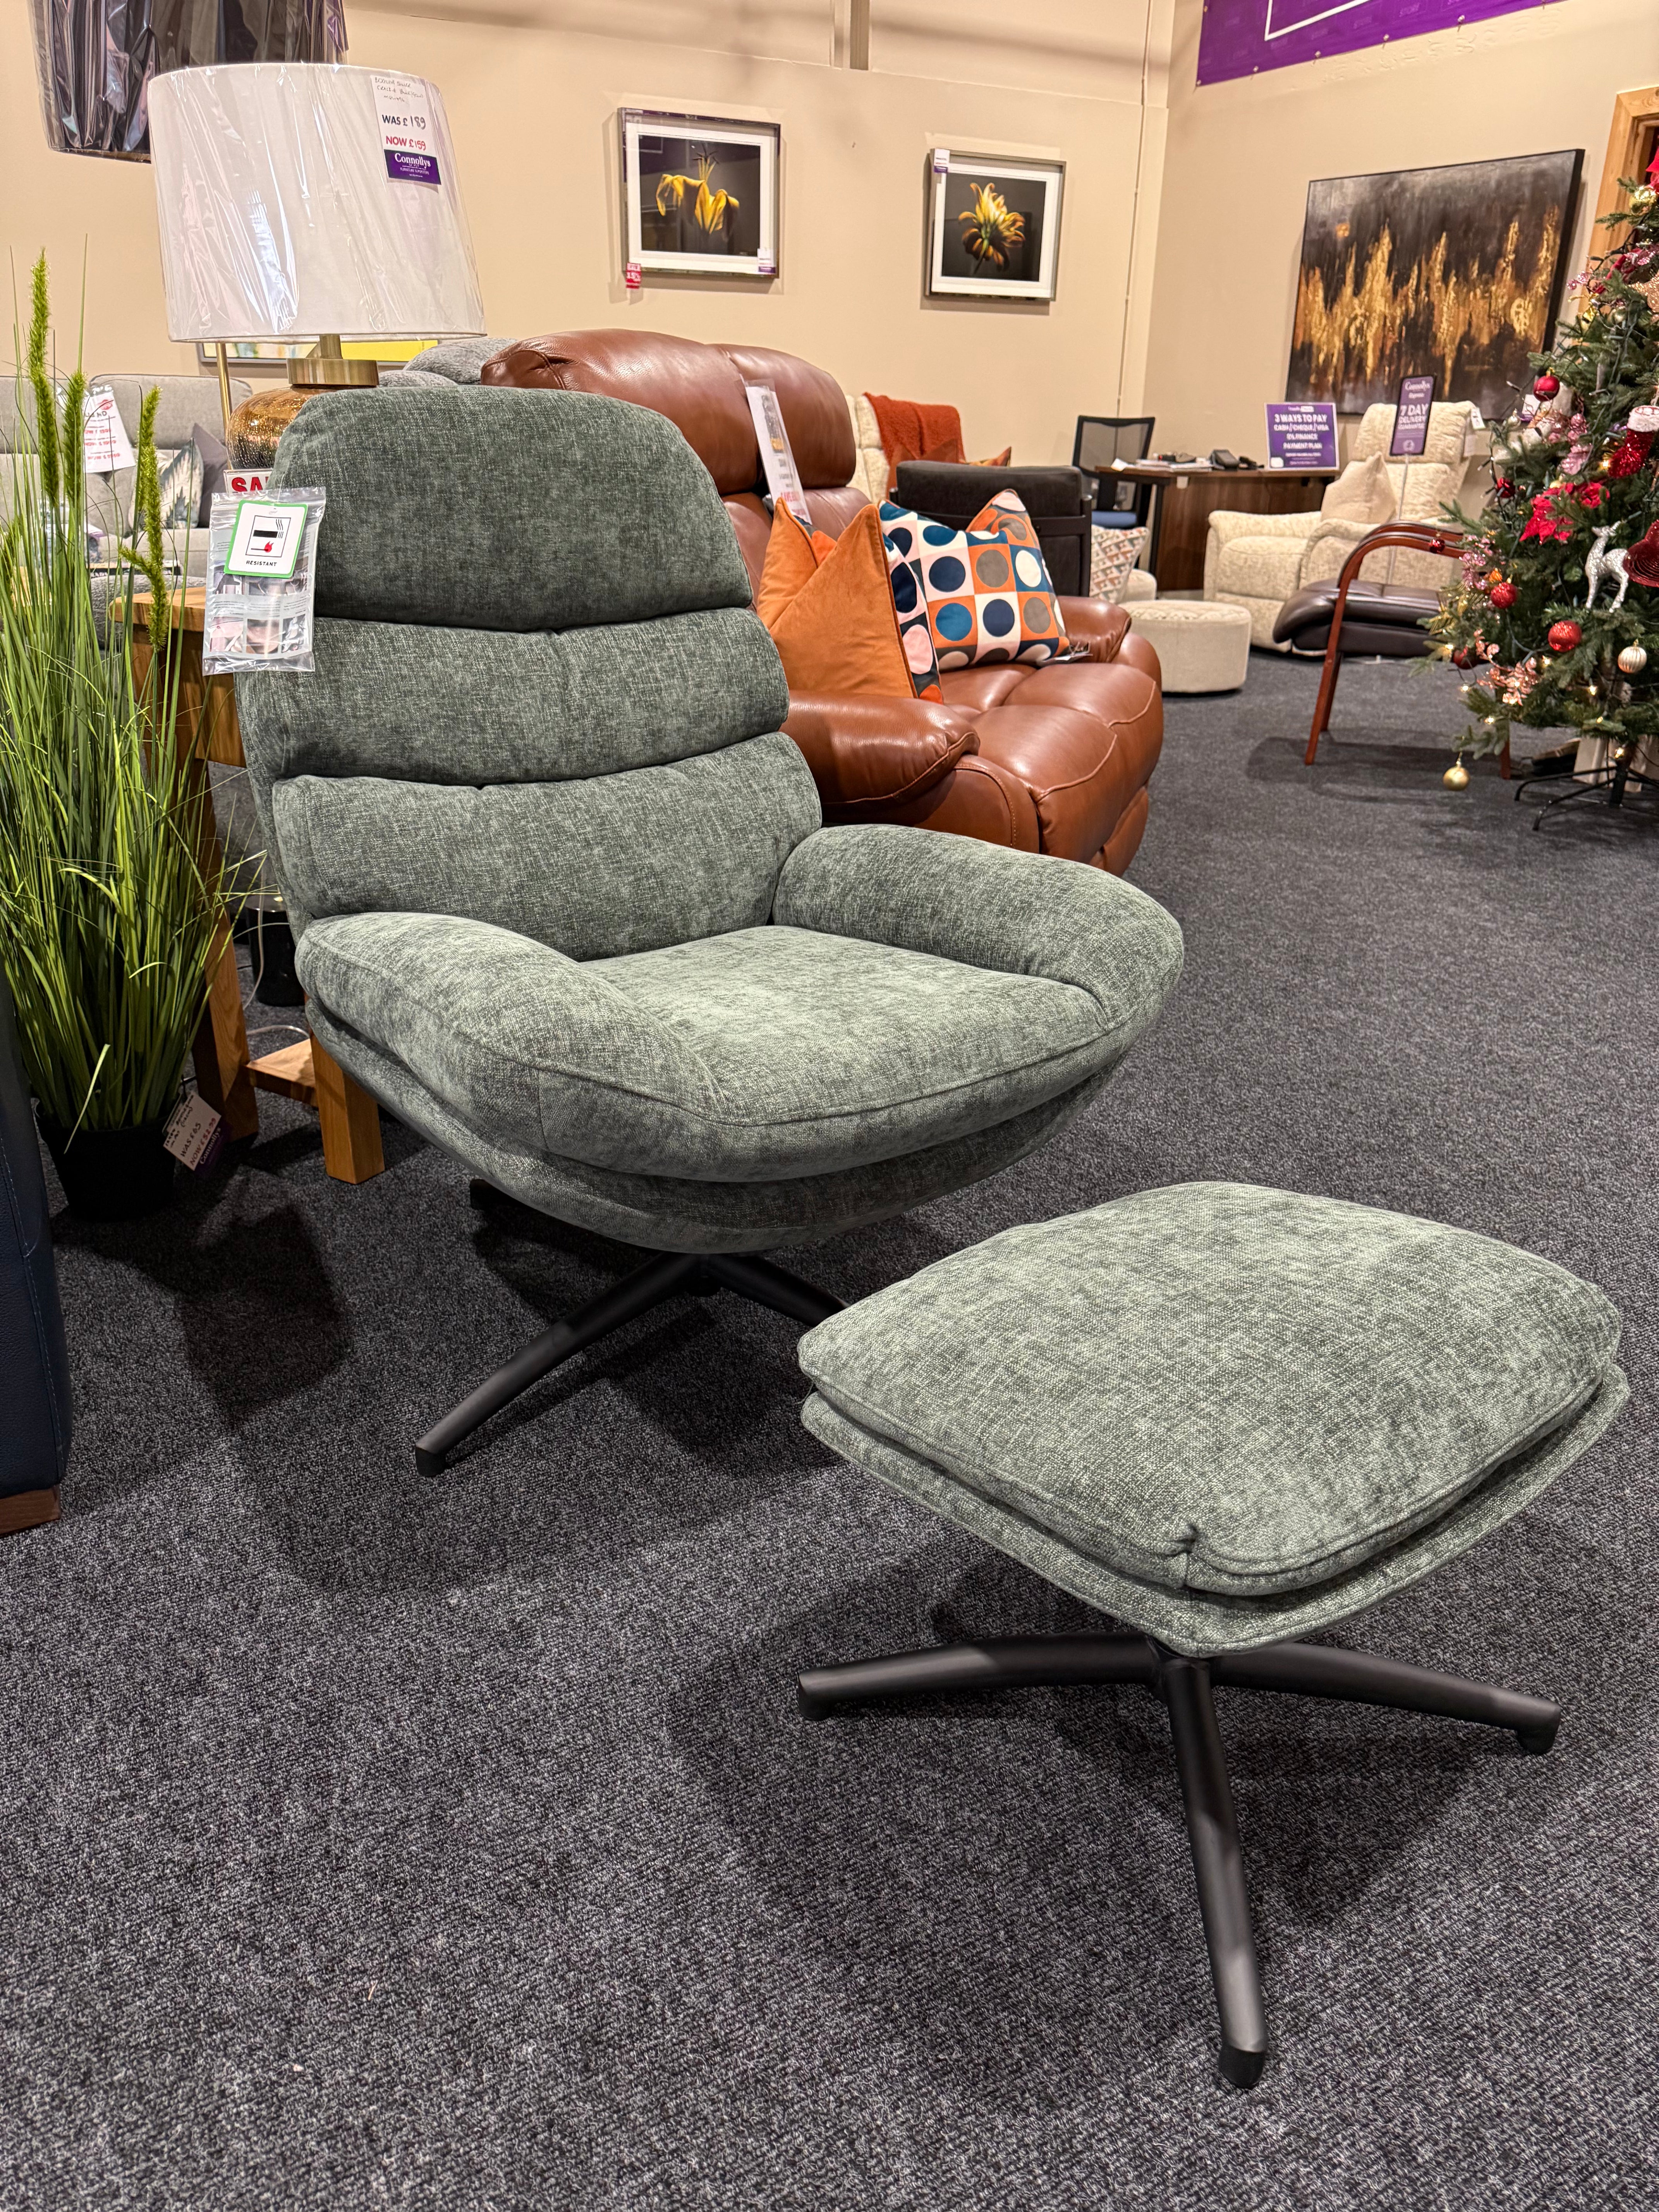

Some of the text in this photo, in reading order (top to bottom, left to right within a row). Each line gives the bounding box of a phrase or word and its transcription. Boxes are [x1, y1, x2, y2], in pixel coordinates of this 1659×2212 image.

[381, 114, 401, 125] WAS
[386, 136, 407, 146] NOW
[394, 153, 431, 168] Connollys
[1400, 404, 1429, 416] 7 DAY
[1280, 414, 1302, 422] WAYS
[1302, 414, 1312, 422] TO
[1313, 414, 1328, 422] PAY
[1398, 416, 1427, 424] DELIVERY
[180, 1139, 191, 1157] WAS
[200, 1128, 221, 1164] Connollys
[190, 1144, 201, 1166] NOW
